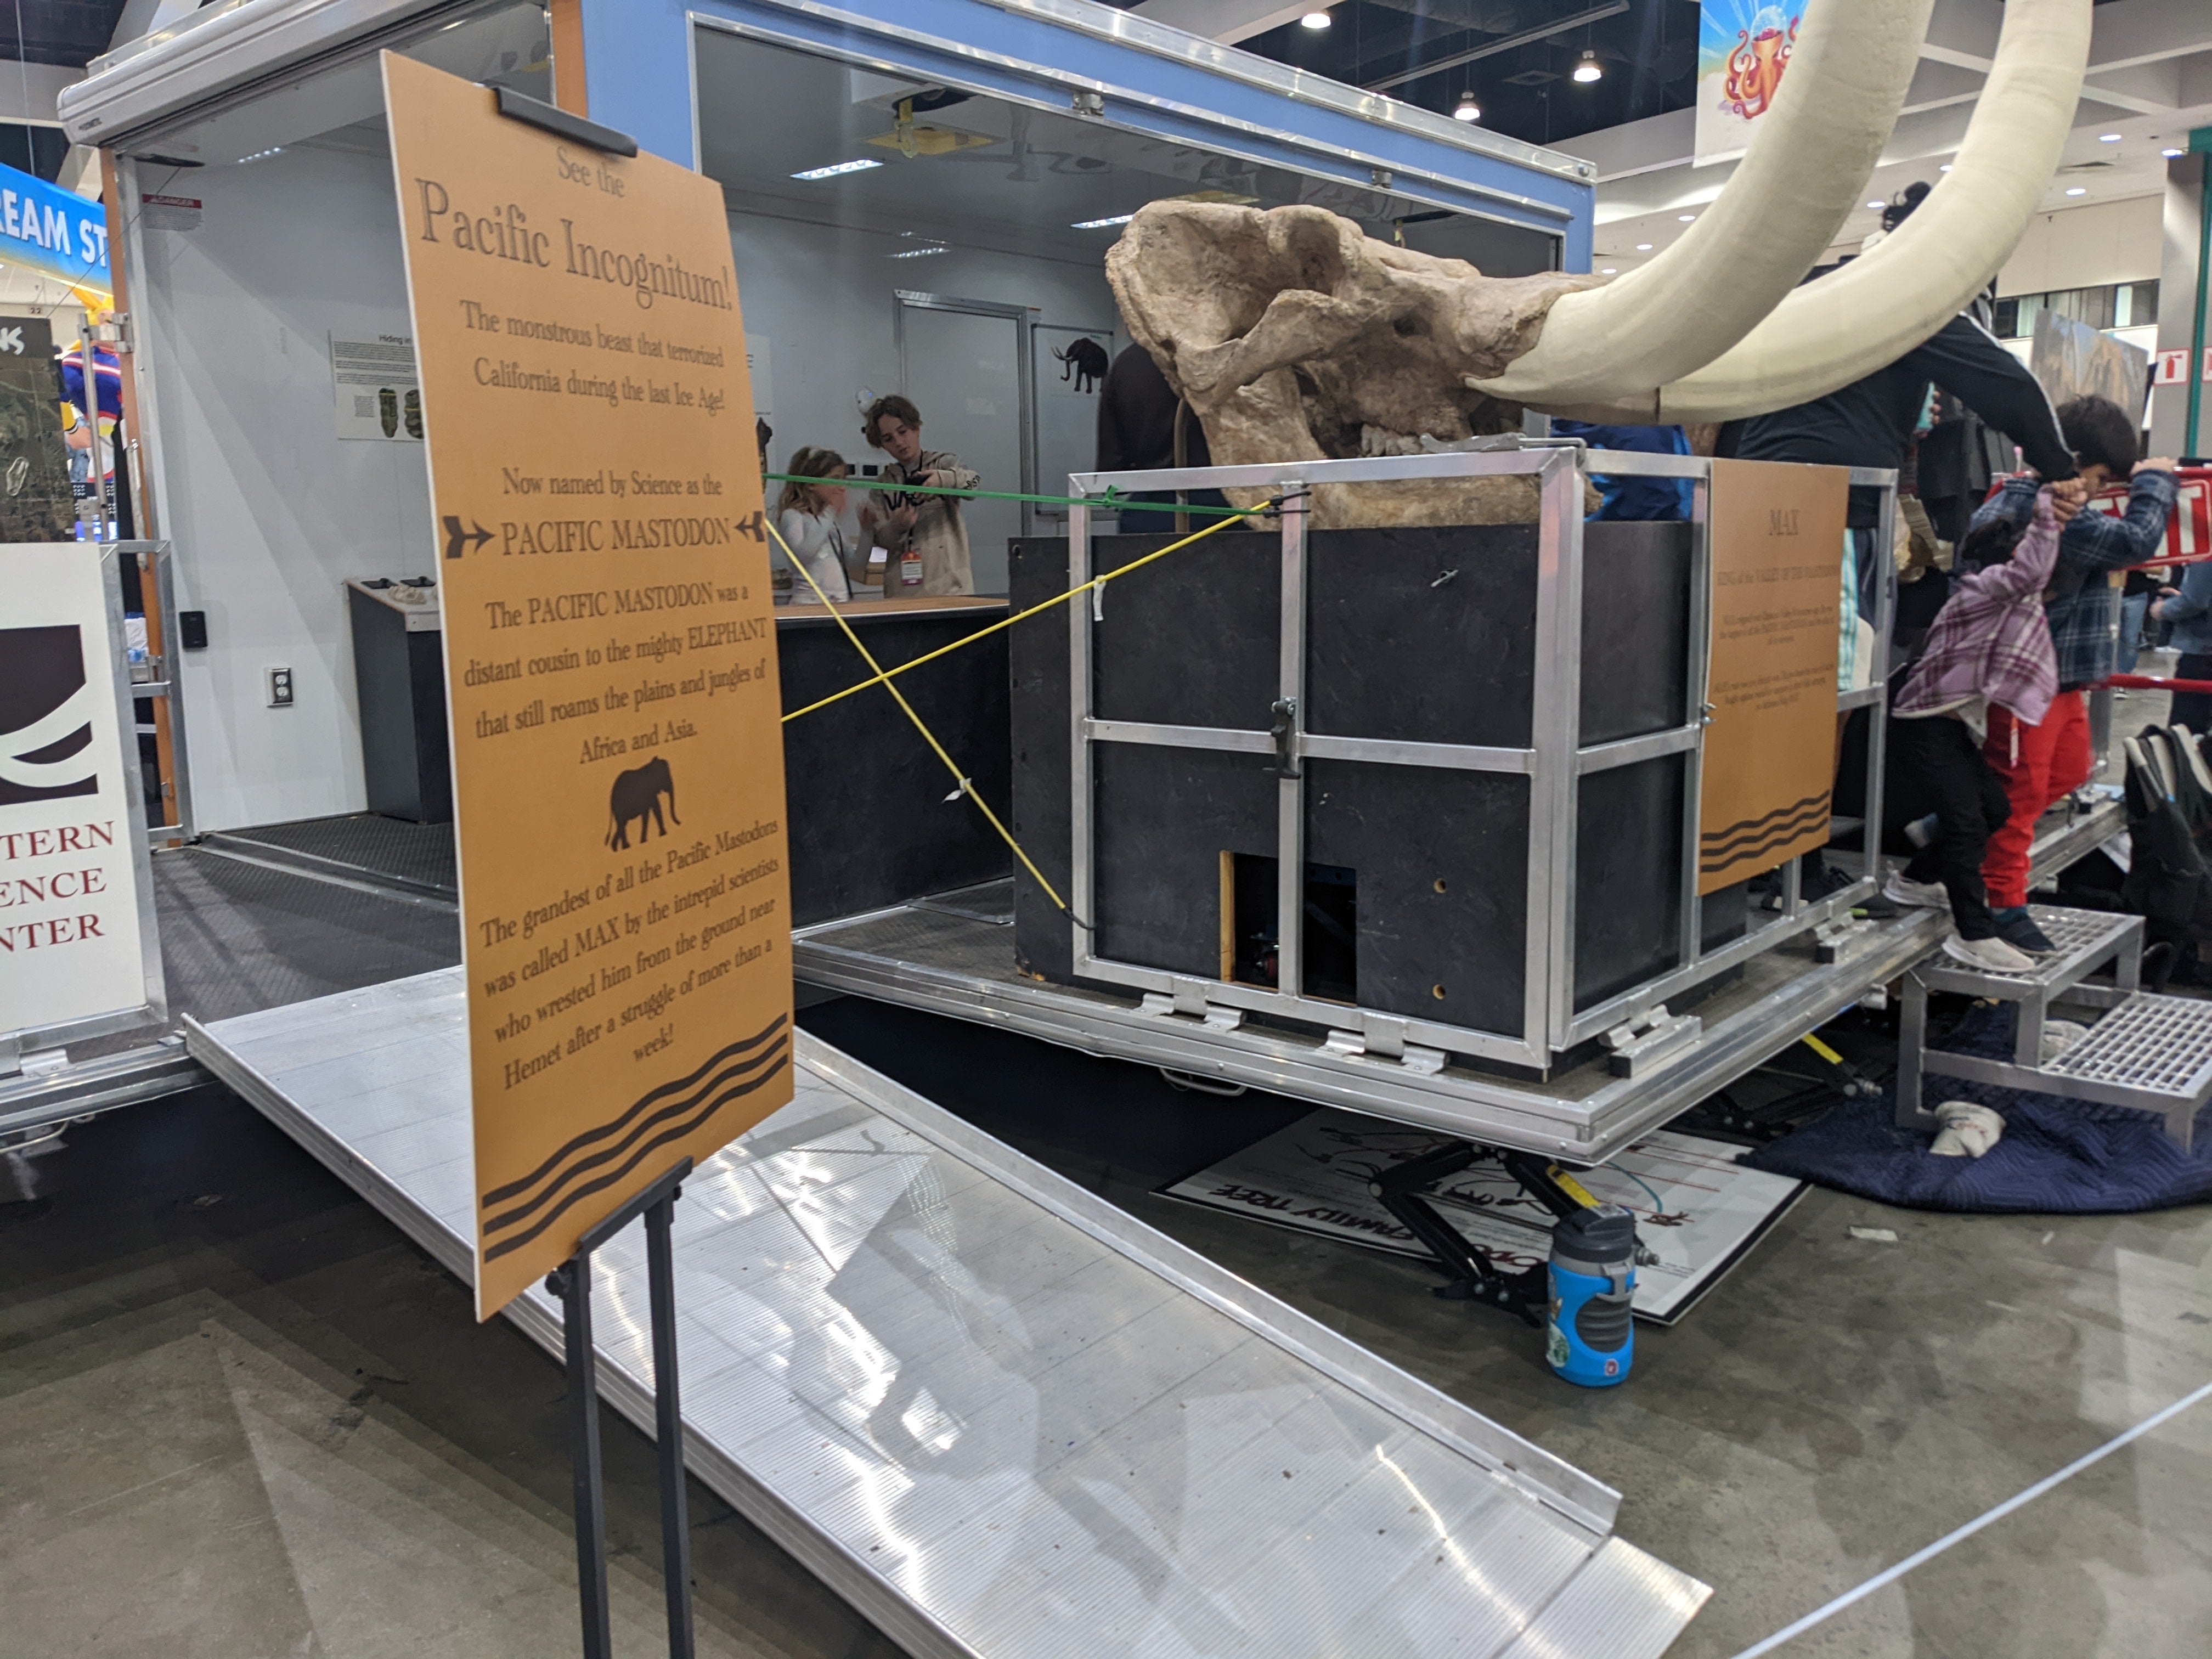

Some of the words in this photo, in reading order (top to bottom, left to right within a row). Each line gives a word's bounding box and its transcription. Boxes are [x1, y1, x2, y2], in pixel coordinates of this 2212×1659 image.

[556, 146, 591, 186] See
[597, 165, 625, 198] the
[0, 189, 71, 256] EAM
[414, 177, 551, 268] Pacific
[560, 218, 732, 309] Incognitum!
[379, 334, 403, 345] Hiding
[459, 299, 500, 332] The
[506, 316, 592, 347] monstrous
[596, 324, 634, 353] beast
[637, 333, 663, 358] that
[667, 341, 724, 368] terrorized
[473, 357, 561, 393] California
[567, 369, 619, 407] during
[622, 375, 645, 402] the
[648, 380, 670, 404] last
[673, 382, 693, 407] Ice
[697, 388, 725, 416] Age!
[501, 467, 543, 495] Now
[550, 471, 603, 495] named
[609, 471, 625, 498] by
[630, 471, 682, 495] Science
[686, 478, 699, 495] as
[703, 473, 723, 495] the
[500, 520, 604, 556] PACIFIC
[611, 517, 731, 550] MASTODON
[486, 602, 522, 629] The
[528, 591, 607, 624] PACIFIC
[614, 582, 713, 614] MASTODON
[717, 587, 738, 603] was
[741, 586, 749, 601] a
[464, 659, 522, 688] distant
[527, 648, 580, 676] cousin
[586, 647, 602, 667] to
[606, 639, 630, 663] the
[636, 632, 684, 664] mighty
[687, 617, 767, 651] ELEPHANT
[476, 711, 509, 739] that
[515, 700, 544, 730] still
[551, 697, 599, 723] roams
[605, 686, 629, 712] the
[634, 680, 676, 712] plains
[680, 669, 705, 694] and
[708, 663, 751, 696] jungles
[754, 658, 766, 680] of
[579, 740, 627, 765] Africa
[632, 724, 658, 751] and
[664, 719, 698, 743] Asia.
[0, 821, 114, 860] TERN
[479, 916, 517, 949] The
[523, 885, 590, 939] grandest
[596, 873, 613, 900] of
[616, 866, 634, 893] all
[639, 858, 661, 884] the
[666, 842, 710, 874] Pacific
[714, 819, 778, 857] Mastodons
[484, 972, 516, 998] was
[521, 939, 568, 981] called
[574, 917, 621, 957] MAX
[625, 912, 642, 936] by
[646, 901, 669, 926] the
[673, 877, 725, 915] intrepid
[728, 856, 780, 890] scientists
[495, 1012, 531, 1043] who
[536, 975, 595, 1022] wrested
[601, 964, 631, 991] him
[636, 946, 672, 974] from
[675, 932, 697, 957] the
[700, 907, 746, 950] ground
[749, 898, 775, 921] near
[504, 1045, 562, 1091] Hemet
[567, 1025, 602, 1055] after
[607, 1018, 616, 1033] a
[620, 983, 675, 1026] struggle
[680, 970, 695, 995] of
[698, 958, 732, 988] more
[734, 944, 761, 969] than
[765, 937, 772, 953] a
[633, 1022, 674, 1063] week!
[1209, 1184, 1294, 1211] TREE
[1290, 1206, 1417, 1241] FAMILY
